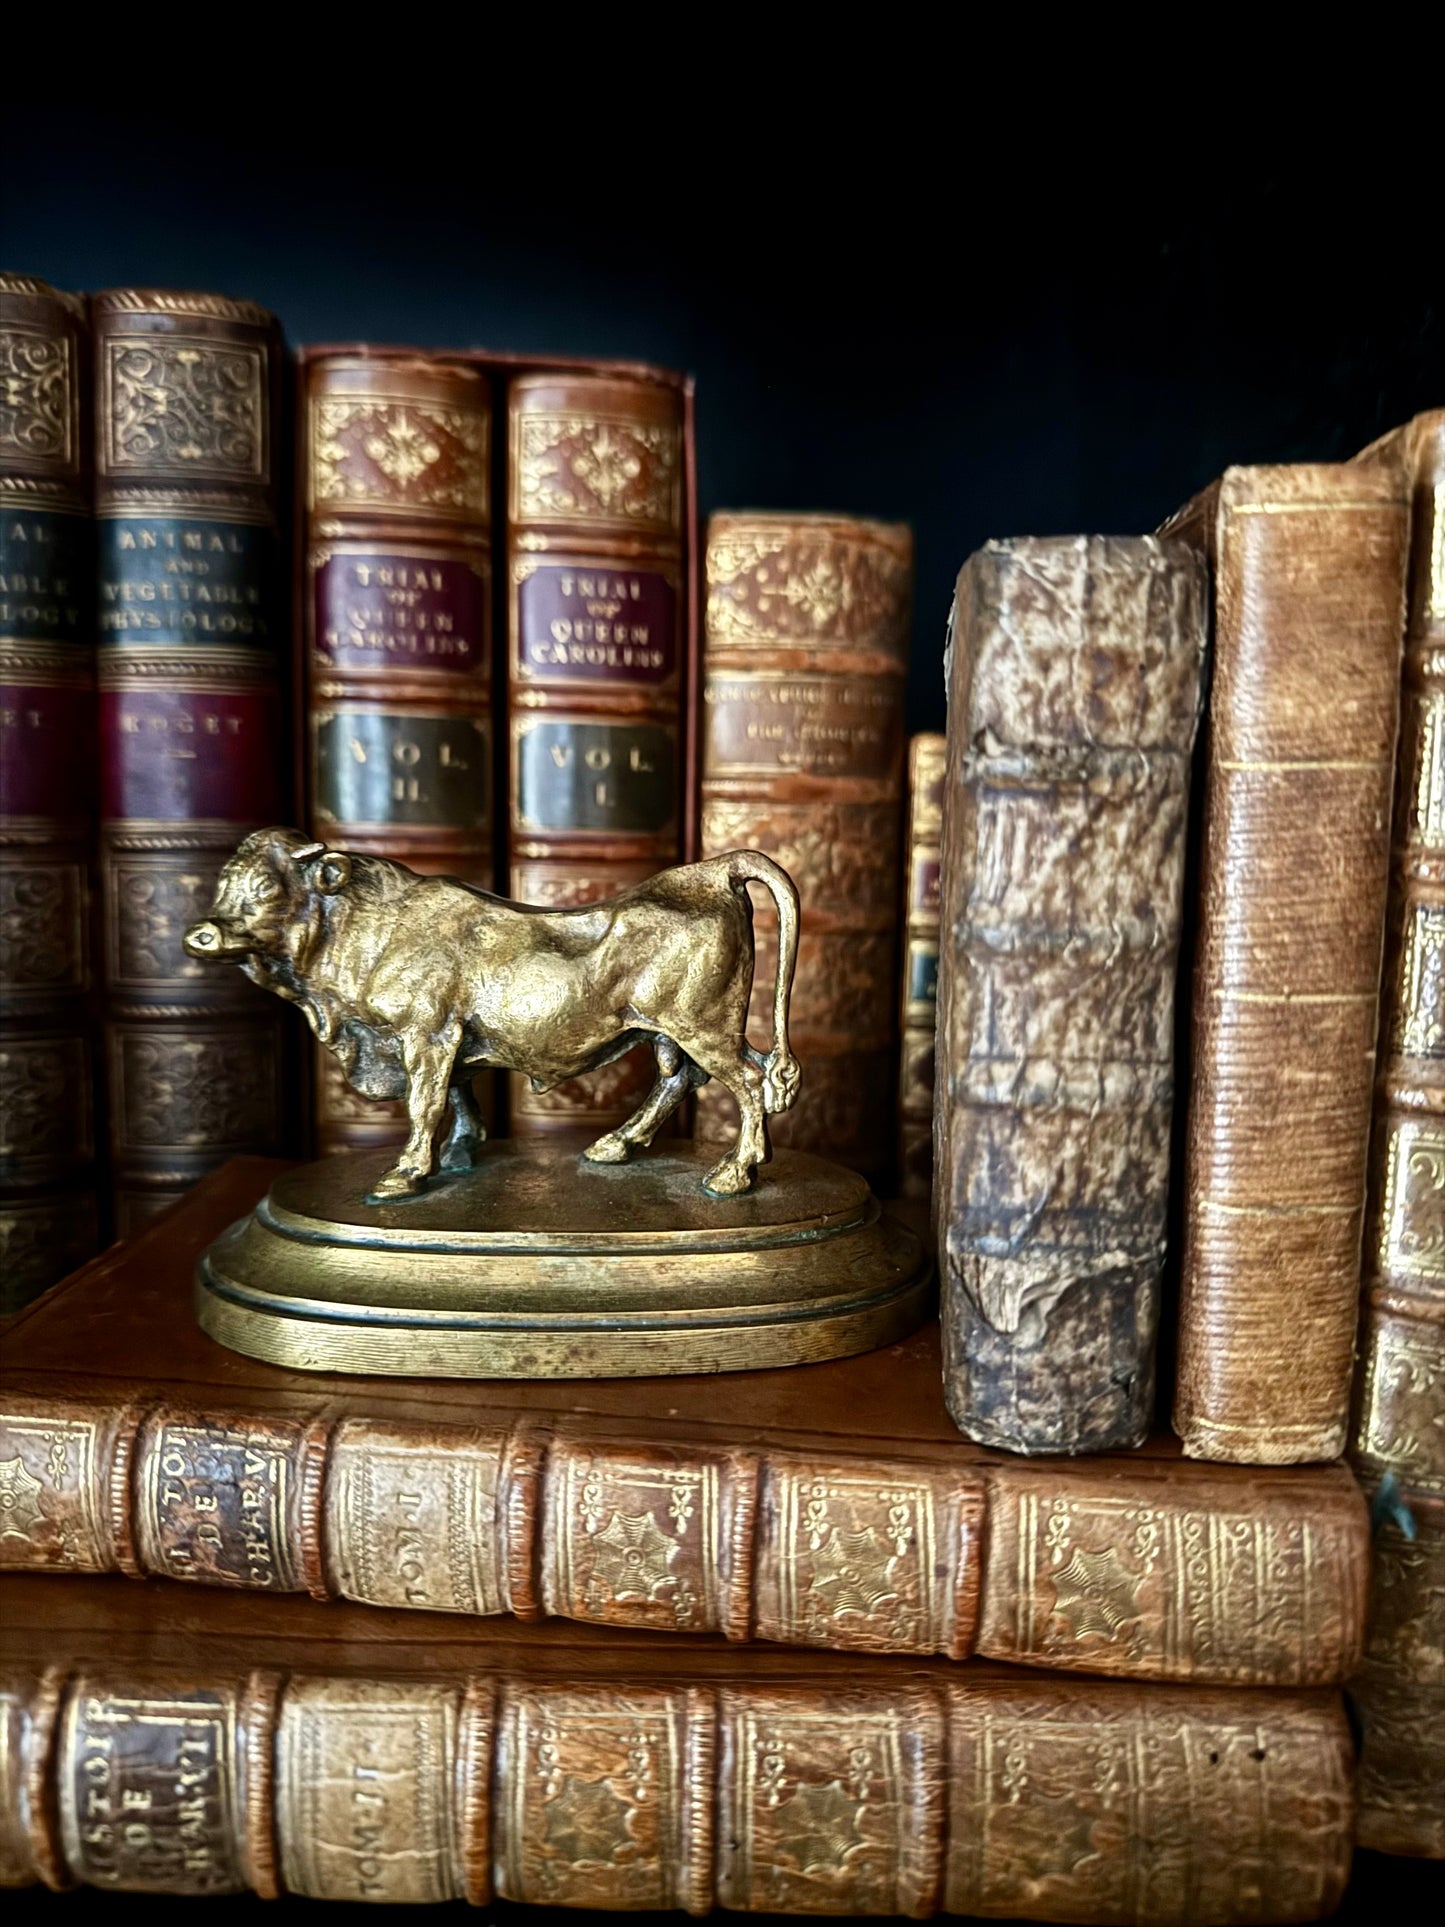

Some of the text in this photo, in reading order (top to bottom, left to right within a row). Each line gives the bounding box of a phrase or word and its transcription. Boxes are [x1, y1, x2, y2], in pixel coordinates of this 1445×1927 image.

[118, 529, 244, 553] ANIMAL
[164, 557, 210, 576] AND
[103, 580, 261, 604] VEGETABLE
[101, 609, 268, 635] PHYSIOLOGY
[121, 712, 243, 735] ROGET
[194, 1493, 224, 1549] DE
